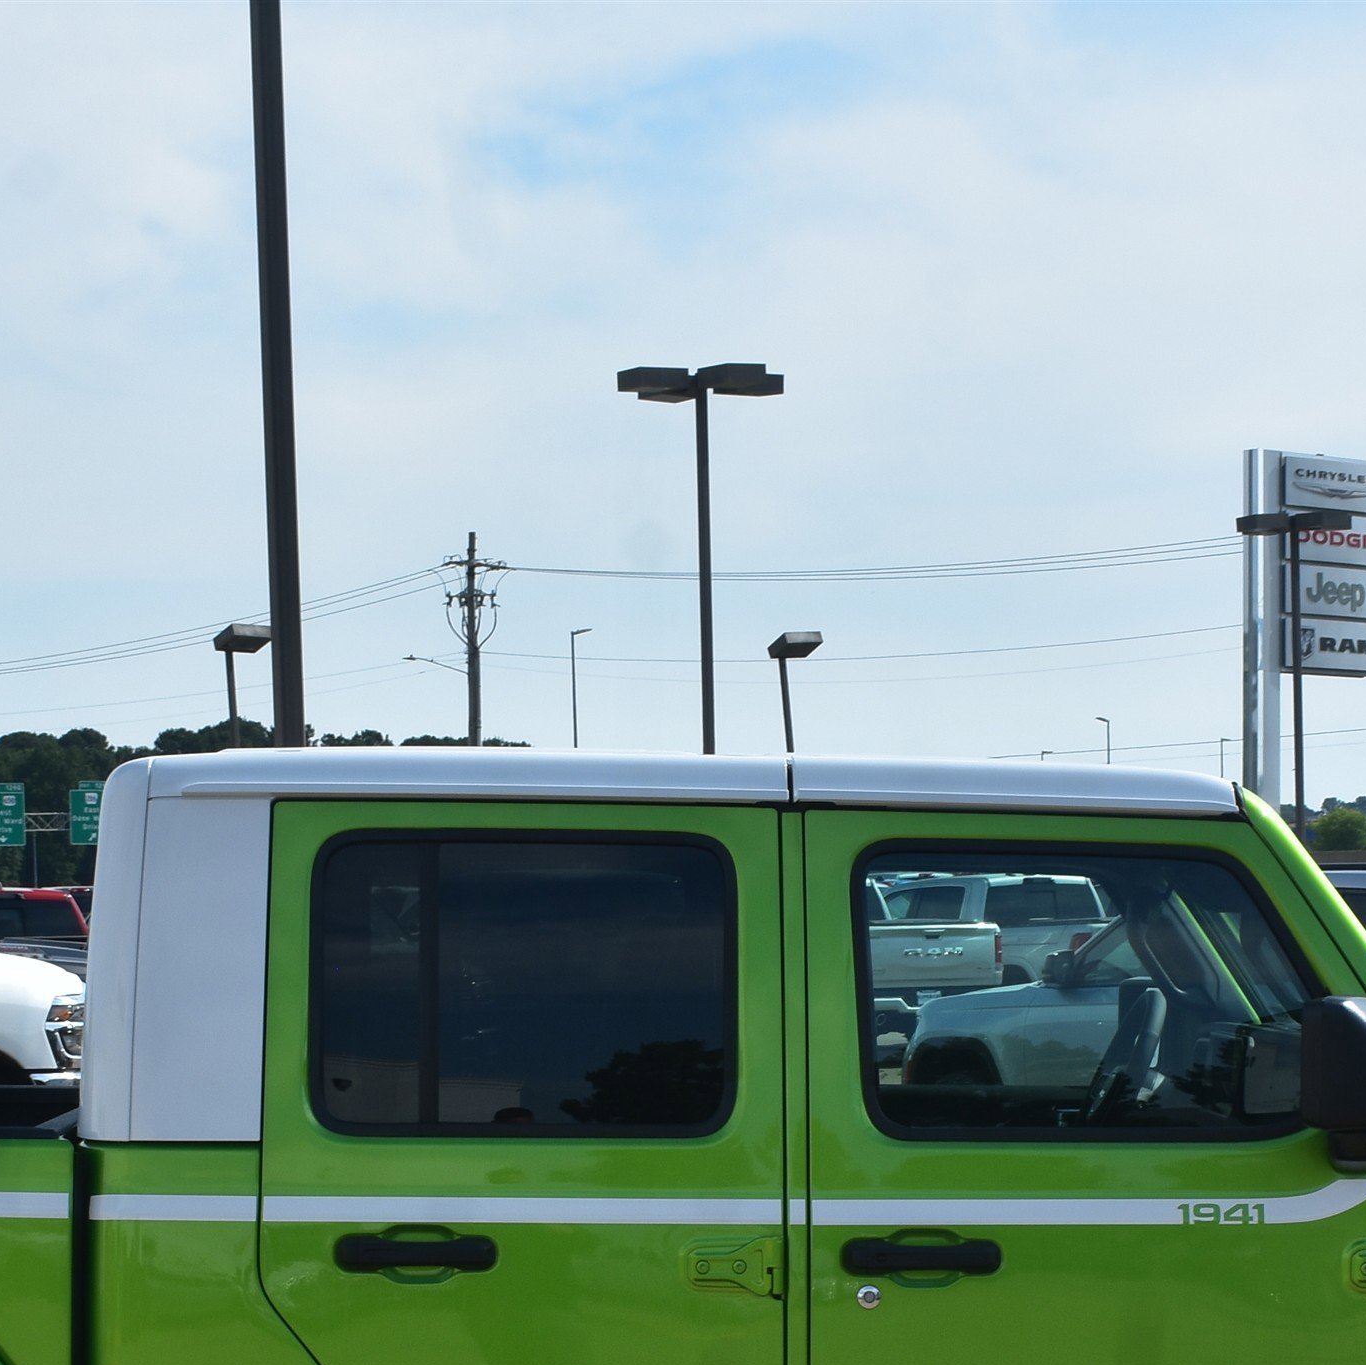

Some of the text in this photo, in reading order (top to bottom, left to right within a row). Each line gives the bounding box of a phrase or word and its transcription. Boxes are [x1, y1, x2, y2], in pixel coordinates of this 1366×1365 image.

[1306, 572, 1366, 613] Jeep
[903, 946, 964, 958] RAM
[1177, 1203, 1265, 1225] 1941
